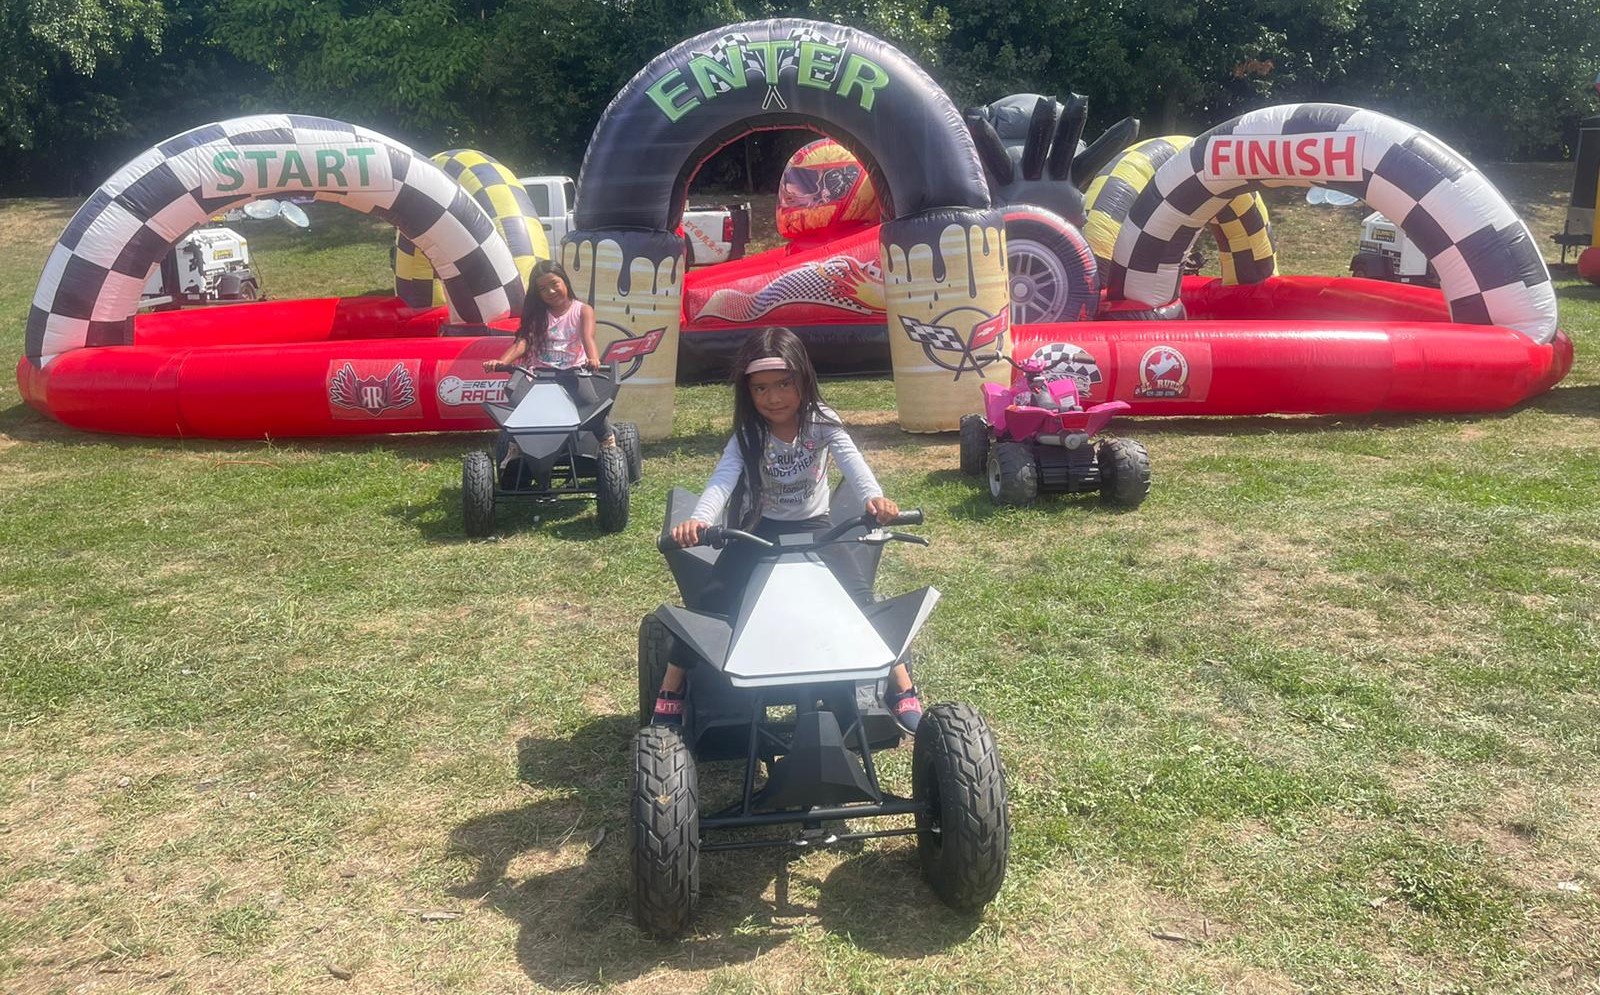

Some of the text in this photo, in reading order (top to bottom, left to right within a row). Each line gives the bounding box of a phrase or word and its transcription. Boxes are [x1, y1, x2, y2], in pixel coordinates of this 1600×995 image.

[645, 40, 890, 124] ENTER
[212, 147, 376, 192] START
[1211, 136, 1356, 177] FINISH
[472, 381, 496, 389] REV
